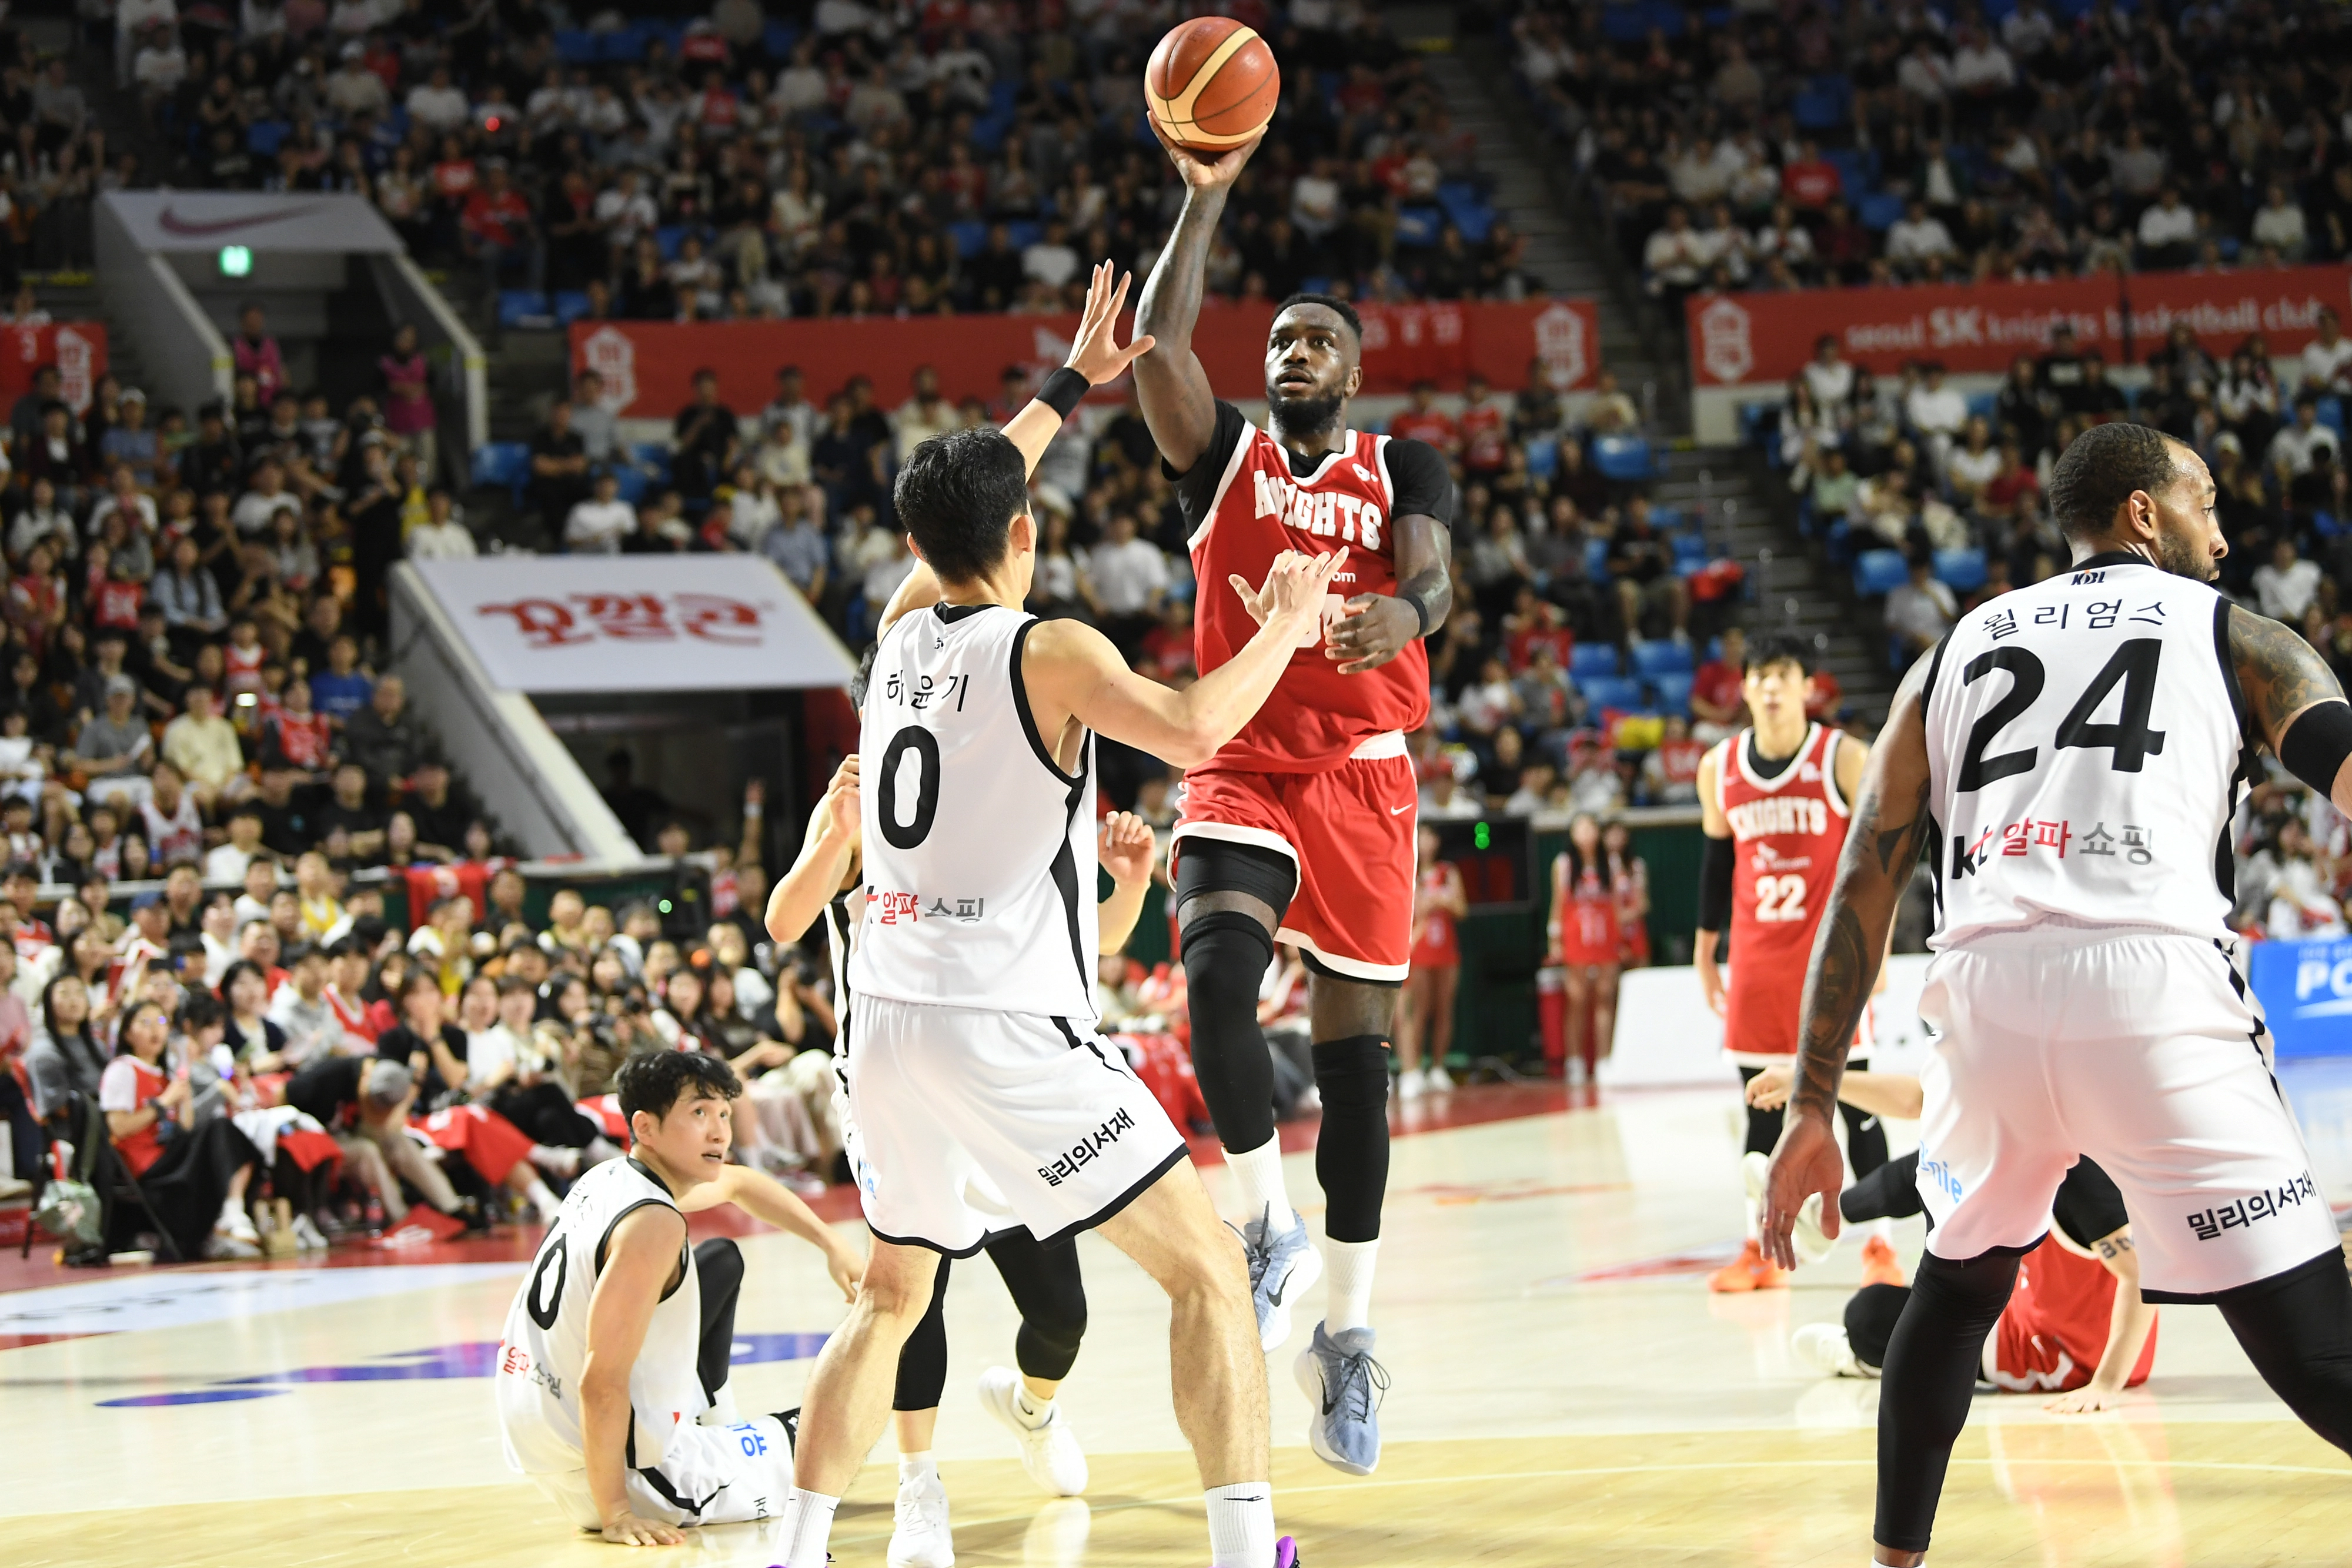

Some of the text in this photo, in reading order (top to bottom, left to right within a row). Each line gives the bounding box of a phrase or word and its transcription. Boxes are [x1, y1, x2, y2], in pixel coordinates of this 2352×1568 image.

[1930, 305, 1983, 348] SK
[1253, 469, 1383, 551] KNIGHTS
[2071, 570, 2106, 586] KBL
[475, 591, 766, 648] 꼬깔콘
[1982, 599, 2167, 641] 윌리엄스
[887, 669, 970, 713] 하윤기
[1956, 637, 2166, 792] 24
[878, 725, 941, 850] 0
[1726, 796, 1828, 842] KNIGHTS
[2002, 817, 2072, 859] 알파
[2079, 821, 2153, 865] 쇼핑
[1755, 874, 1808, 922] 22
[1037, 1106, 1135, 1187] 밀리의서재
[2186, 1169, 2317, 1241] 밀리의서재
